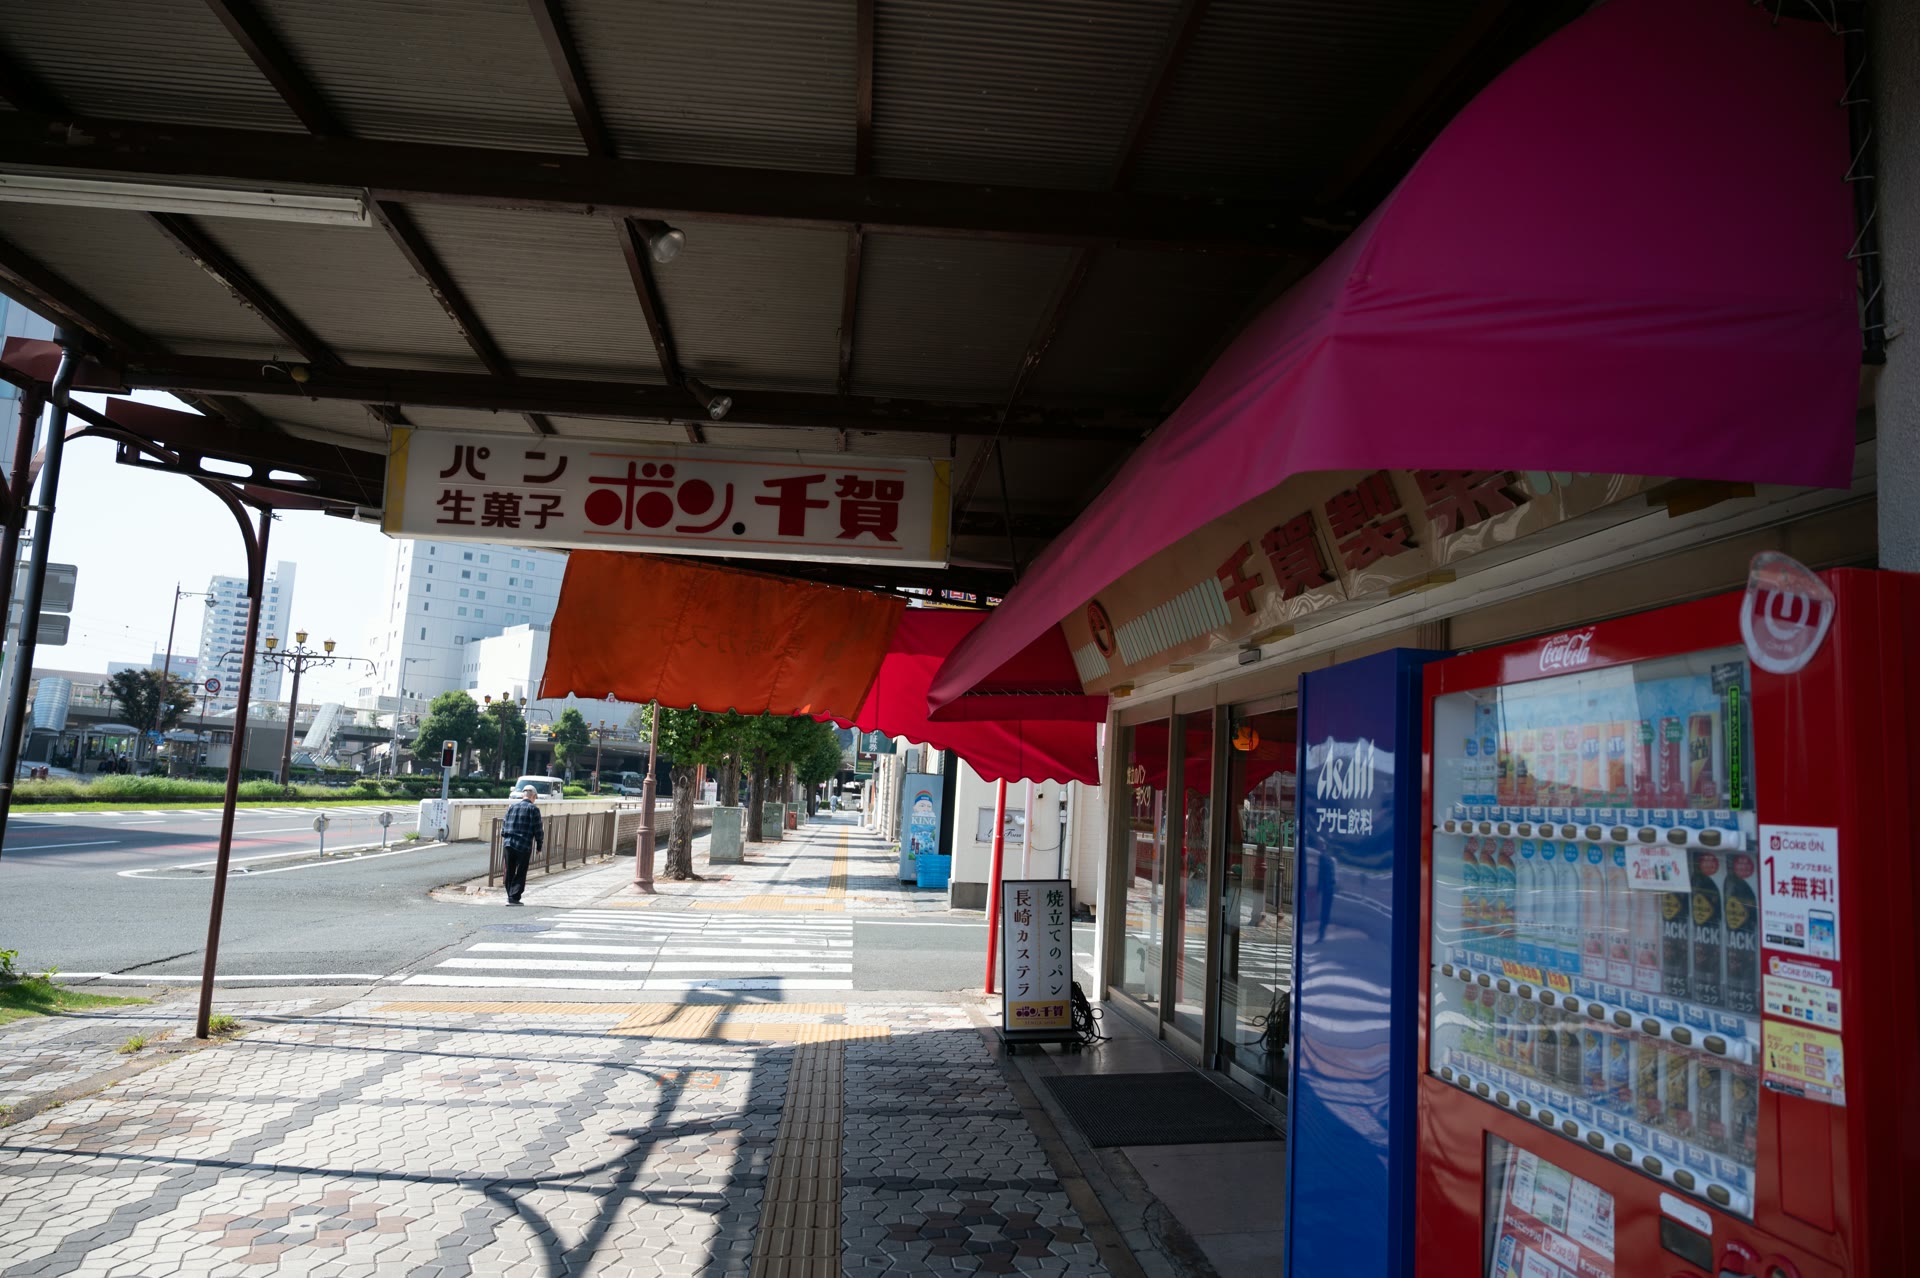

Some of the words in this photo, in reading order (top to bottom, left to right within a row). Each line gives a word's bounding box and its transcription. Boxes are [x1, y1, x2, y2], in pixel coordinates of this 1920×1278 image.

[440, 443, 568, 484] パン
[436, 488, 564, 531] 生菓子
[1317, 739, 1374, 800] Asahi
[911, 816, 936, 825] KING
[1316, 808, 1373, 835] アサヒ飲料
[1782, 839, 1806, 850] Coke
[1013, 889, 1033, 997] 長崎カステラ
[1046, 889, 1065, 997] 焼立てのパン
